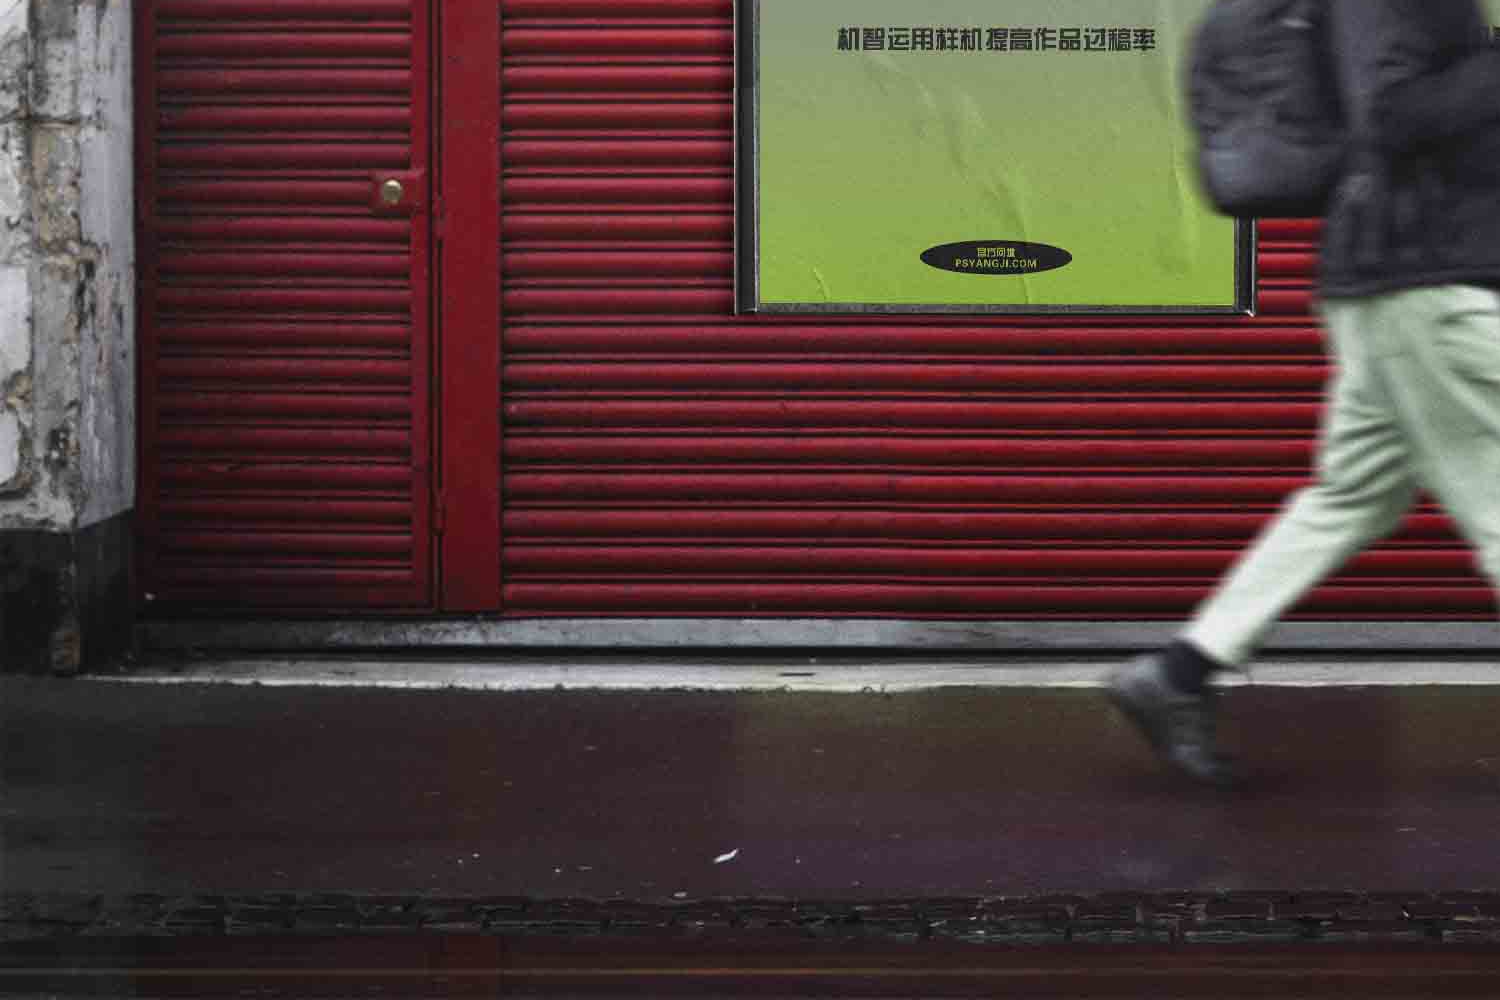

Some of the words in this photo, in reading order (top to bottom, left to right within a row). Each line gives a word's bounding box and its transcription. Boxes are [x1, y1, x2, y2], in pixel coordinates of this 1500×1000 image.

[837, 27, 1156, 51] 机智运用样机提高作品过稿率
[955, 258, 1037, 268] PSYANGJI.COM
